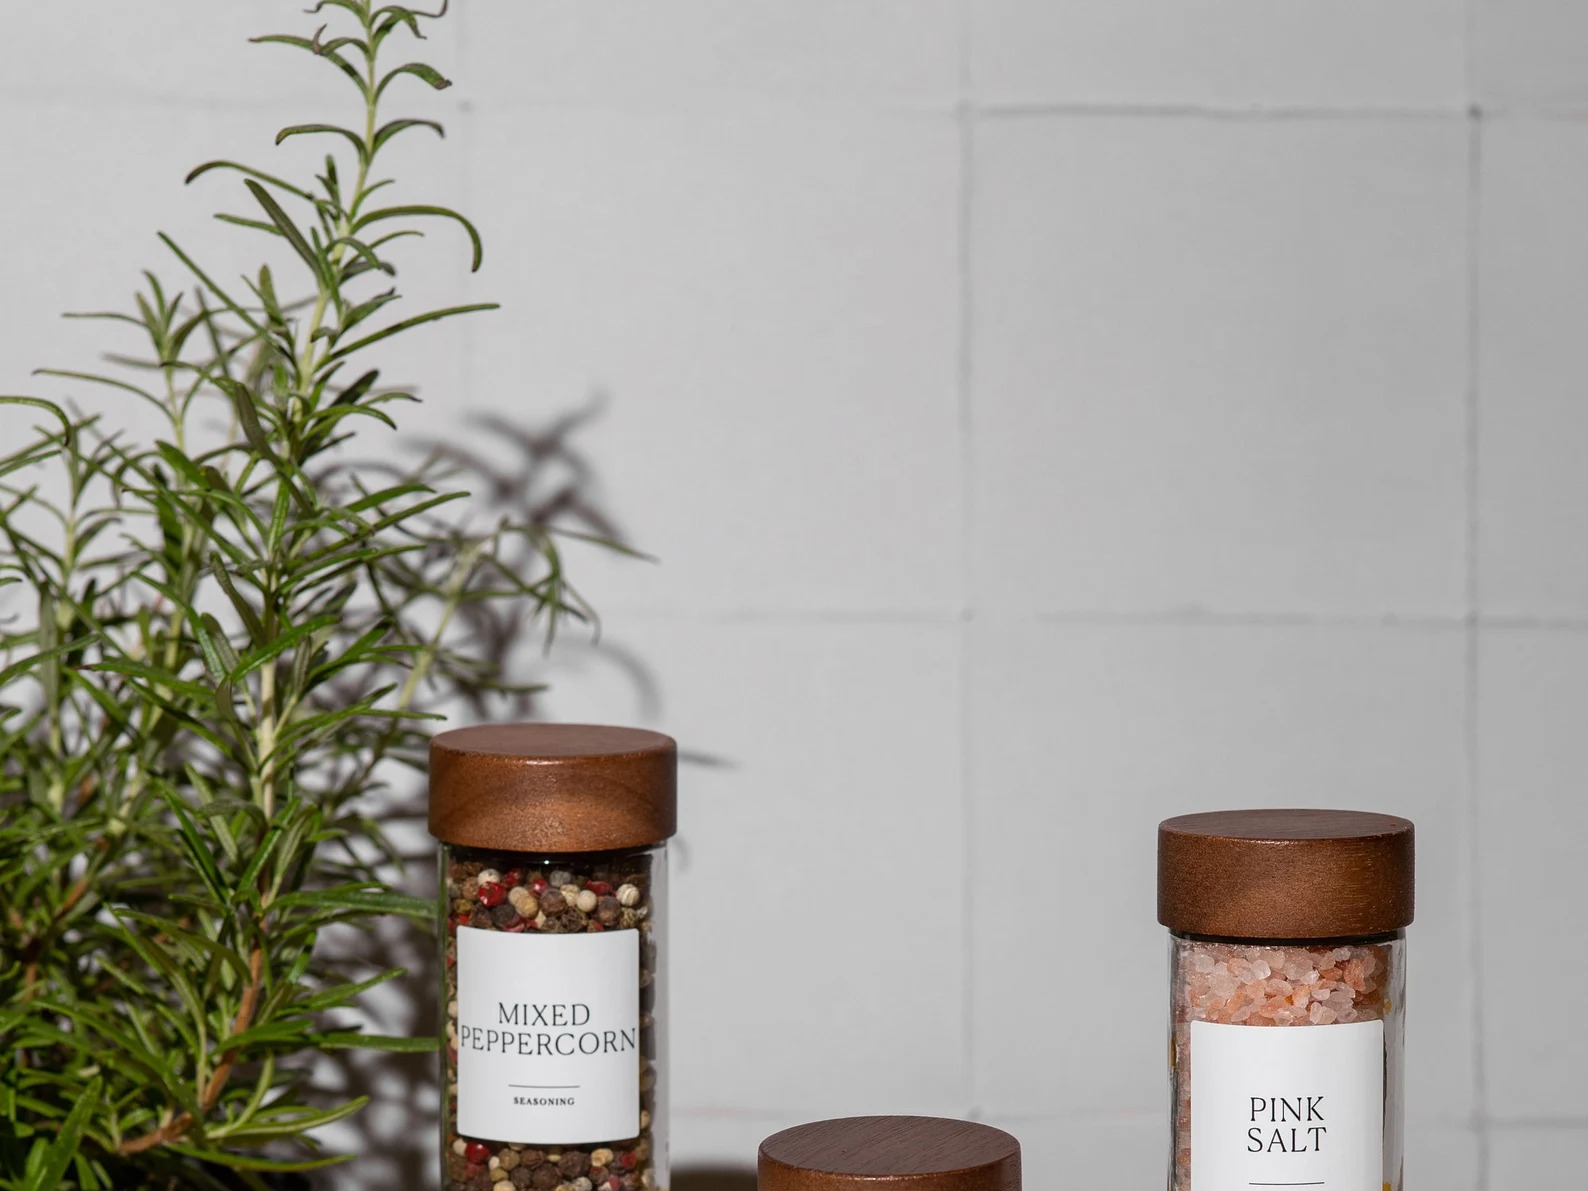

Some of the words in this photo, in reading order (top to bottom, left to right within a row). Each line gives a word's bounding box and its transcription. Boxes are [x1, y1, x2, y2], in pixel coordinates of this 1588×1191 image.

[498, 1001, 591, 1027] MIXED
[460, 1024, 636, 1056] PEPPERCORN
[512, 1095, 576, 1107] SEASONING
[1249, 1095, 1326, 1123] PINK
[1246, 1126, 1328, 1153] SALT
